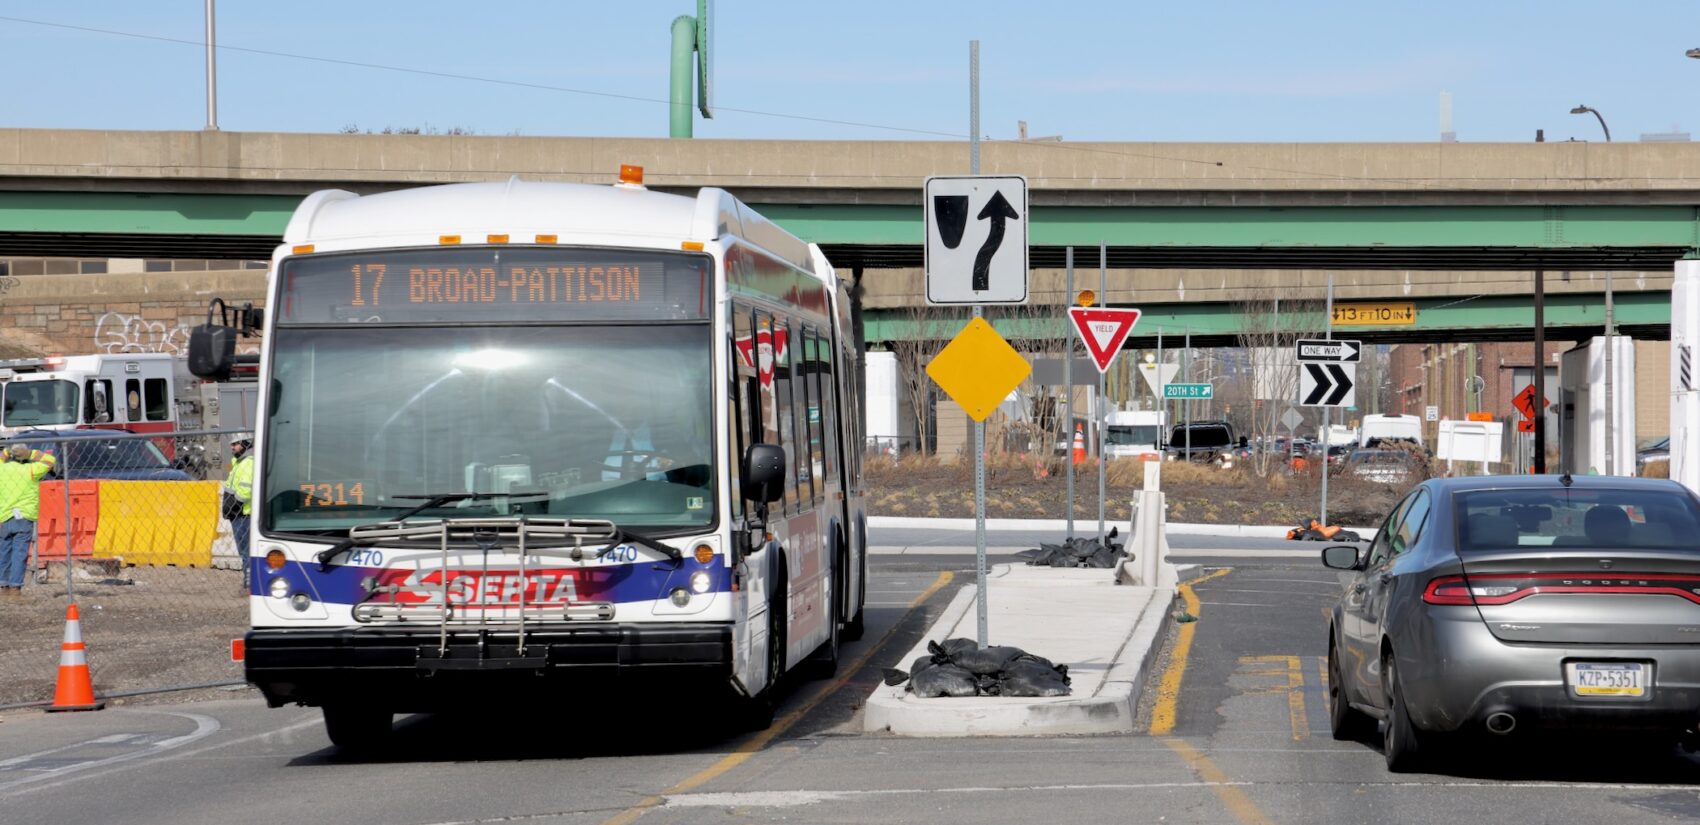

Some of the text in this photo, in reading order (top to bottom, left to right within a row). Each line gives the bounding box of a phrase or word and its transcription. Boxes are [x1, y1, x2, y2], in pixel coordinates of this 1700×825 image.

[350, 264, 640, 306] 17 BROAD-PATTISON
[1341, 308, 1404, 320] 13 FT 10 IN
[1303, 346, 1341, 355] ONE WAY
[1167, 386, 1187, 396] 20TH
[300, 482, 364, 507] 7314
[345, 549, 383, 566] 7470
[597, 545, 637, 563] 7470
[447, 574, 578, 603] SEPTA
